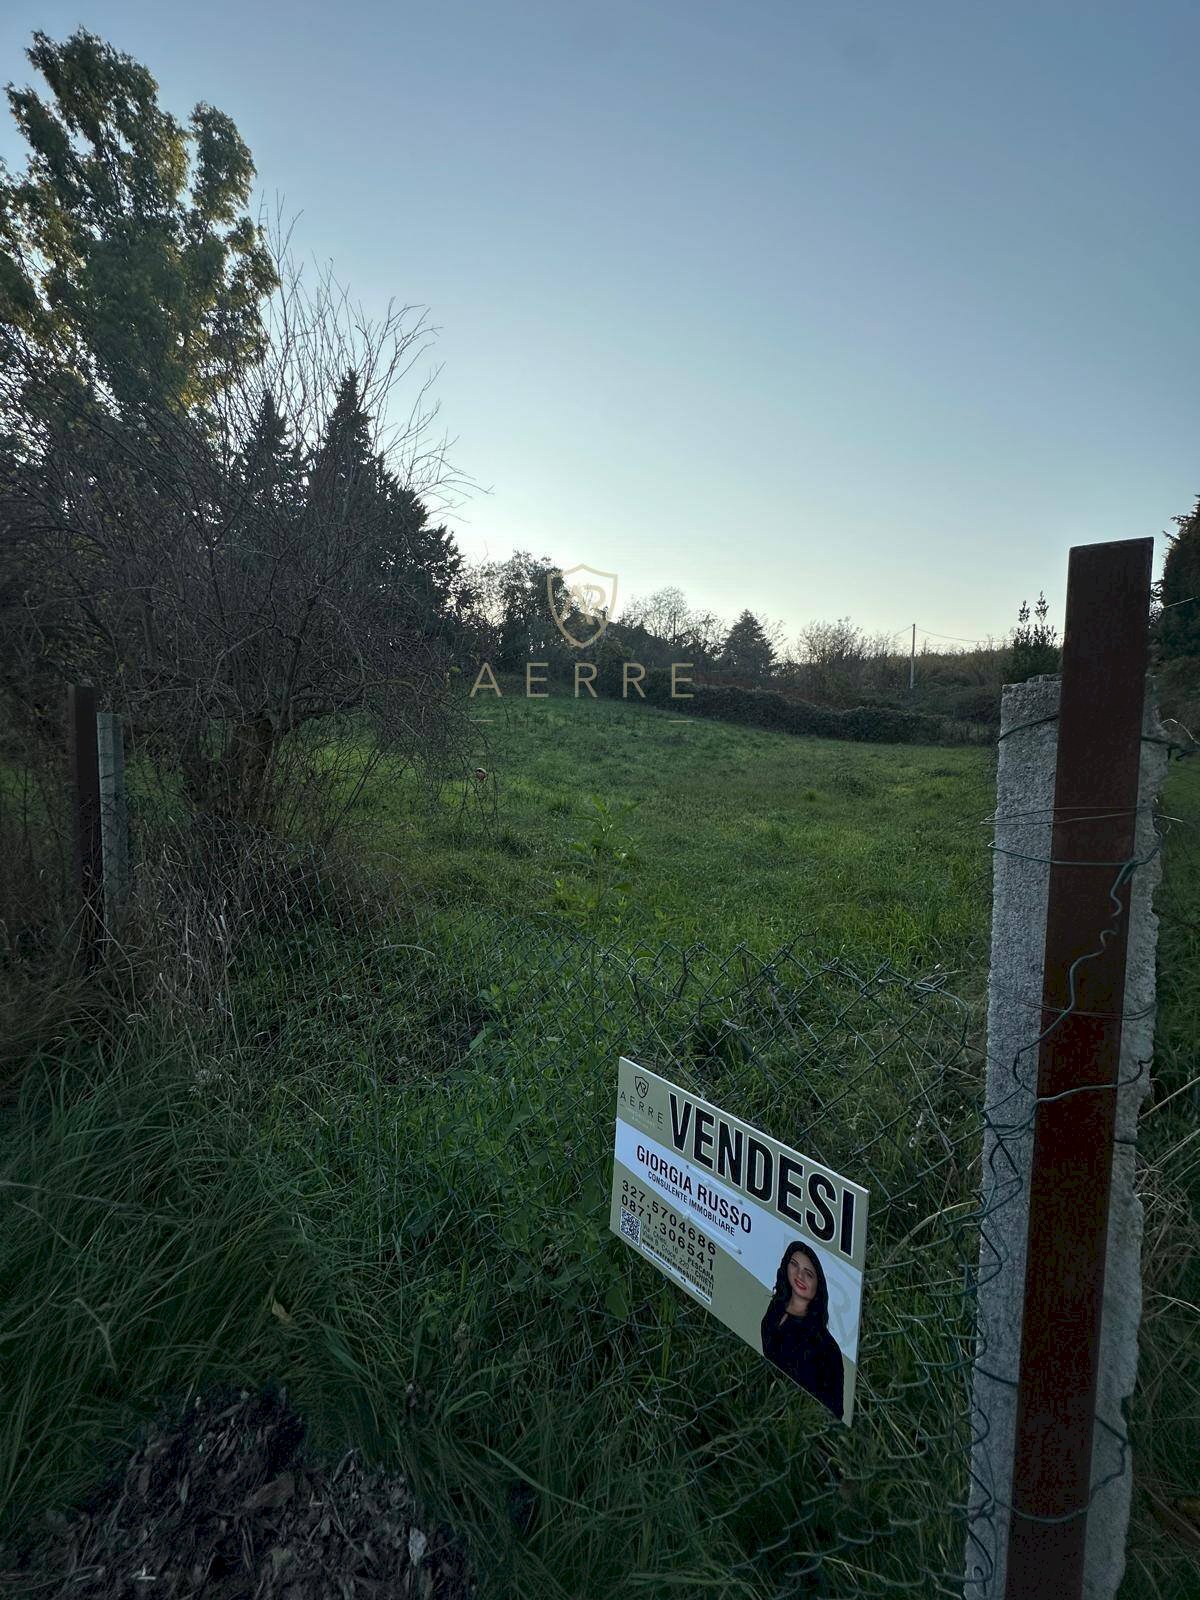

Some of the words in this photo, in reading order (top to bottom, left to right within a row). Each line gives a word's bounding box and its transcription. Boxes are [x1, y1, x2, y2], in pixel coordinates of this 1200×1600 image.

[620, 1091, 664, 1124] AERRE
[636, 1145, 692, 1195] GIORGIA
[698, 1183, 751, 1234] RUSSO
[648, 1171, 687, 1204] CONSULENTE
[689, 1197, 735, 1237] IMMOBILIARE
[669, 1092, 855, 1258] VENDESI
[621, 1194, 713, 1271] 0871.306541
[622, 1180, 716, 1256] 327.5704686
[695, 1270, 713, 1290] CHIETI
